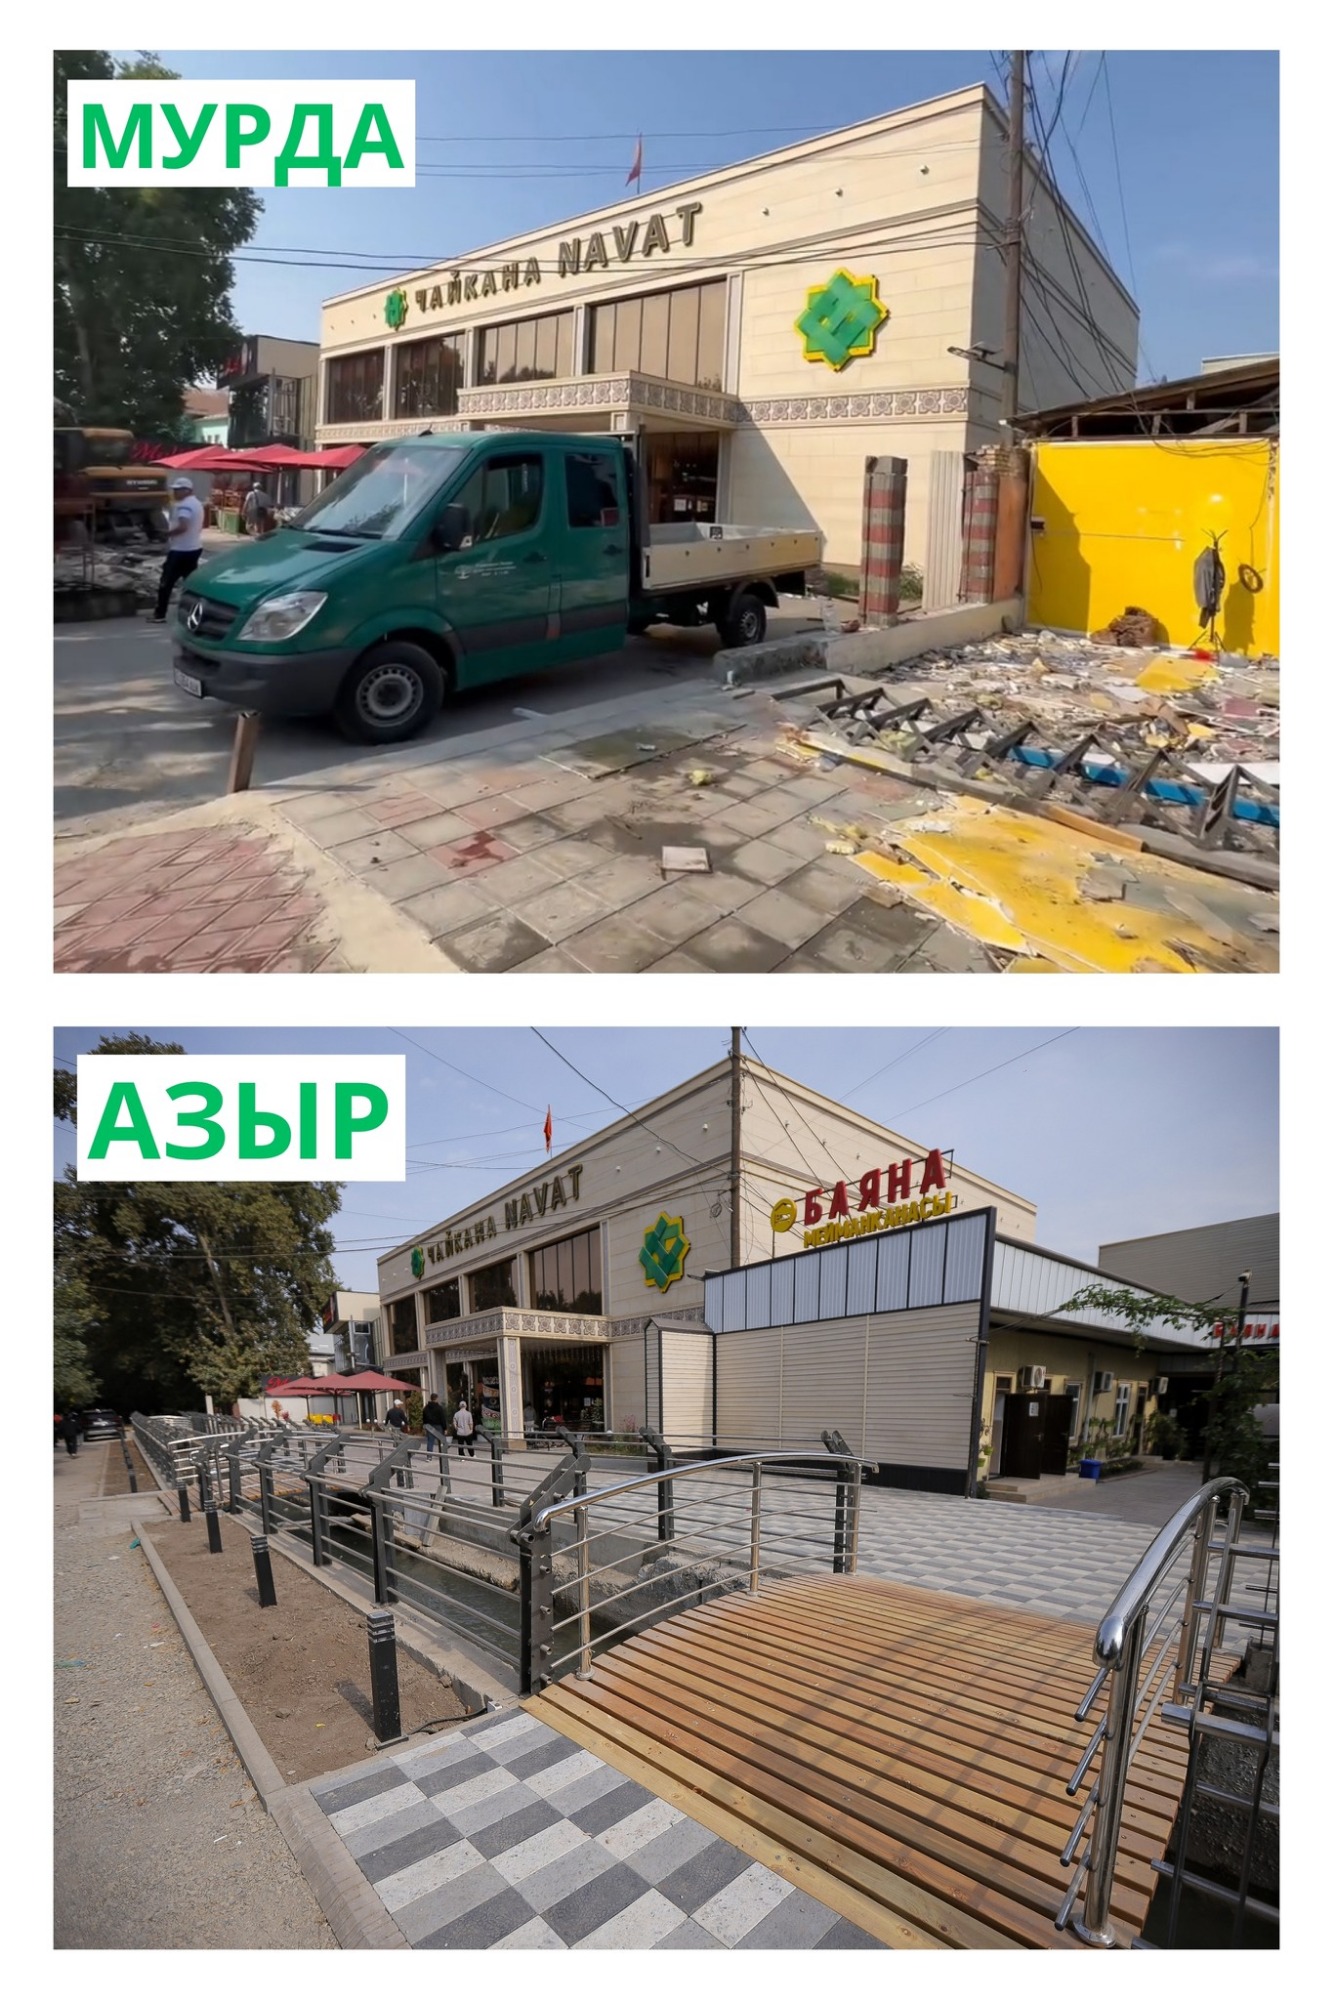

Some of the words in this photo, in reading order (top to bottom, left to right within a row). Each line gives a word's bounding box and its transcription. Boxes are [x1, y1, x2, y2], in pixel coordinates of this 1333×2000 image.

[415, 257, 541, 312] ЧАЙКАНА
[558, 202, 702, 277] NAVAT
[427, 1216, 497, 1264] ЧАЙКАНА
[504, 1164, 583, 1230] NAVAT
[804, 1149, 946, 1226] БАЯНА
